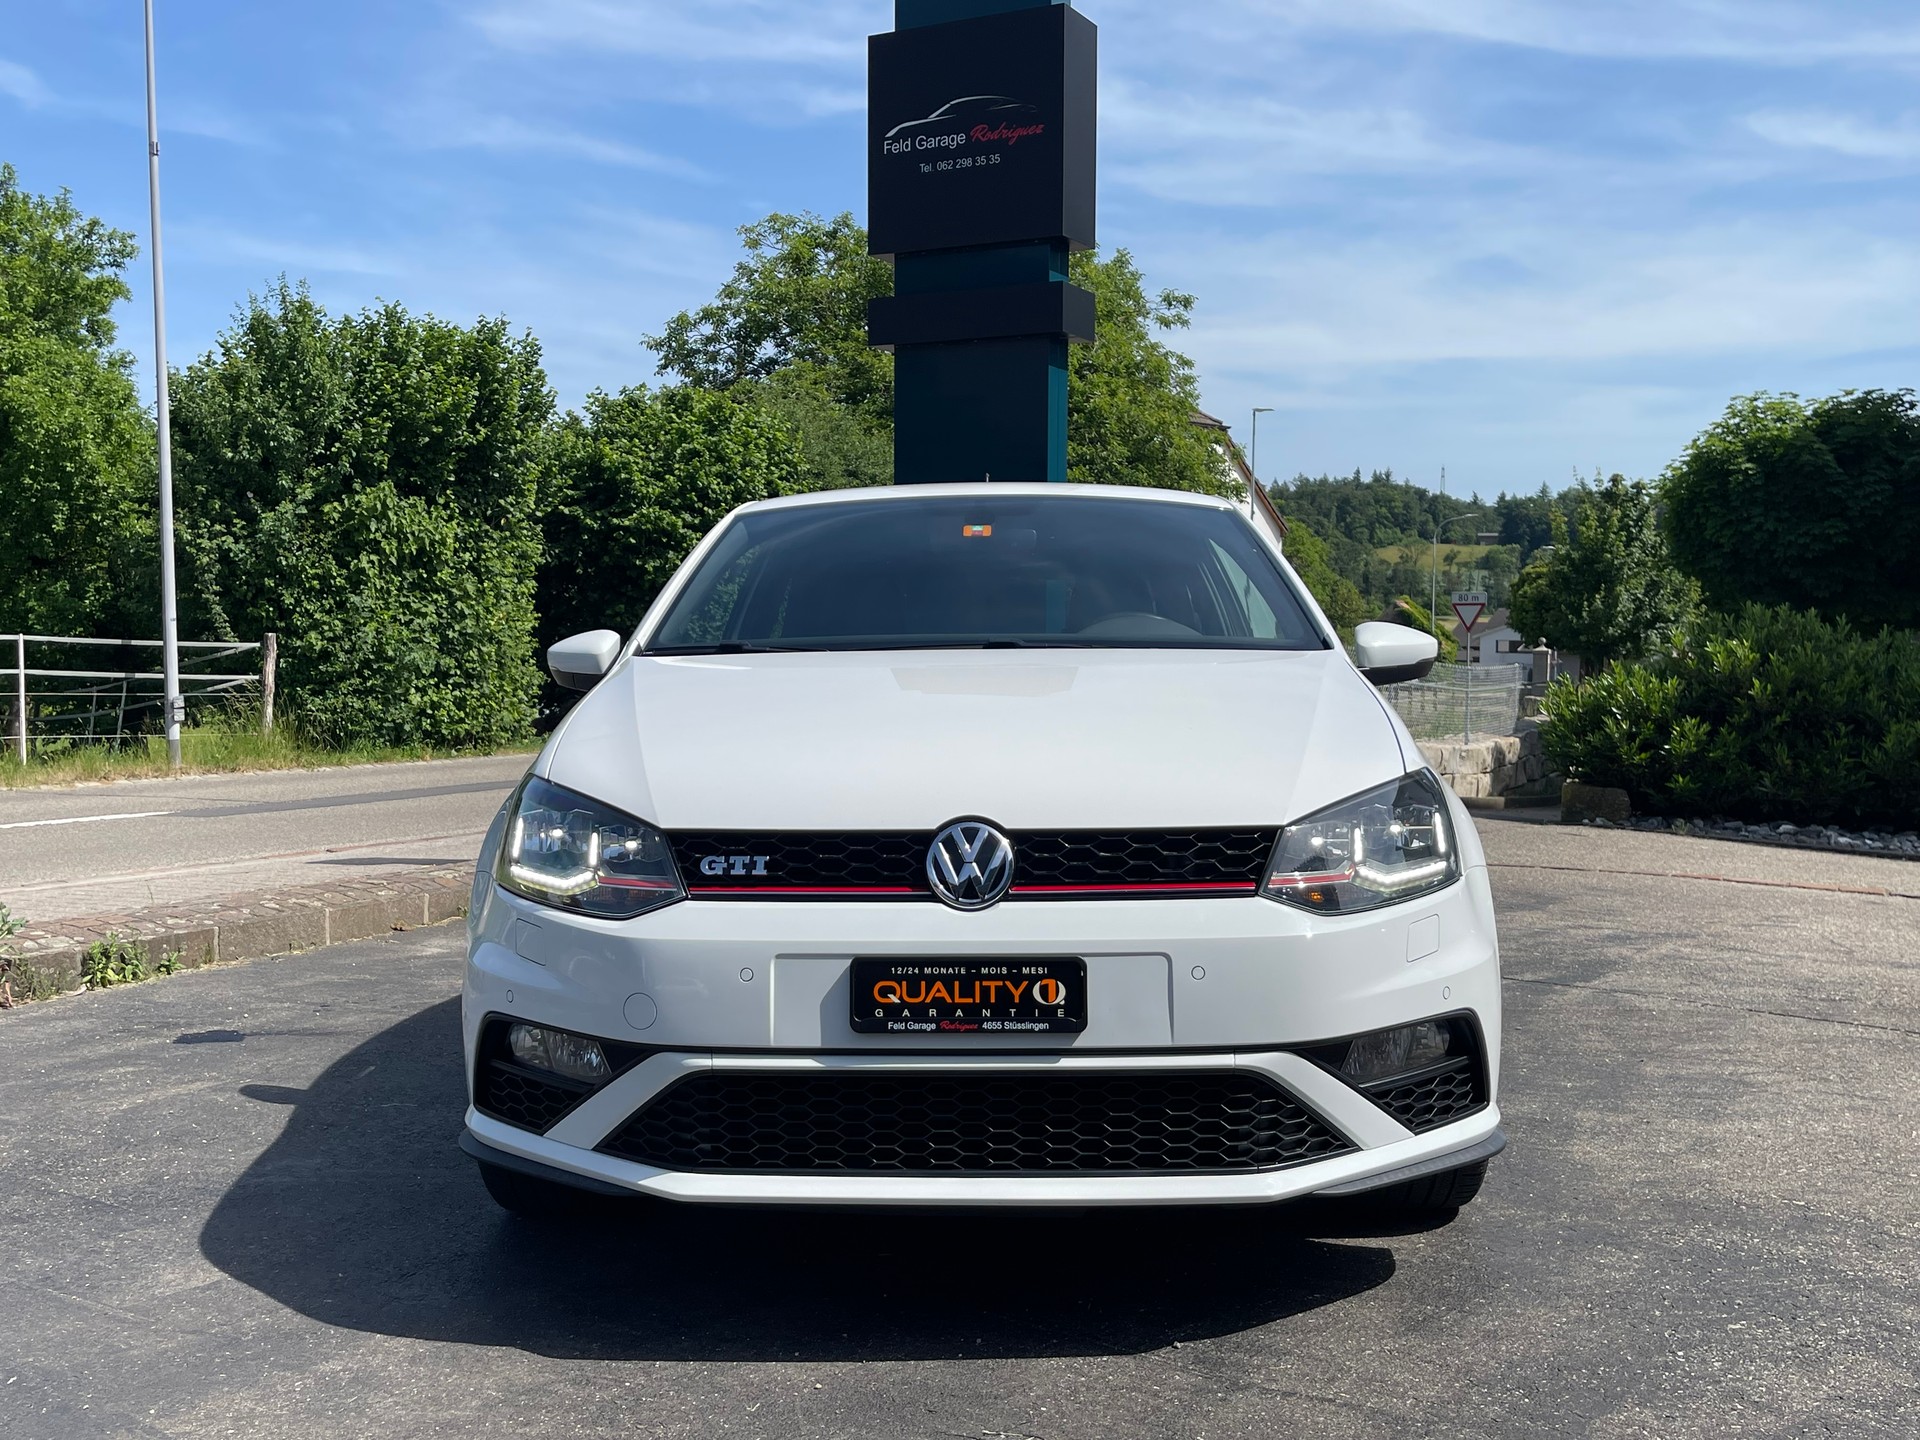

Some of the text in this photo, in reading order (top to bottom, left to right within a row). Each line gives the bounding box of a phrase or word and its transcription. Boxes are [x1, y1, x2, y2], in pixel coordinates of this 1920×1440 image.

[883, 122, 1046, 155] Feld Garage Rodriguez
[919, 153, 1001, 173] Tel. 062 298 35 35
[700, 855, 770, 876] GTI
[891, 967, 919, 975] 12/24
[924, 967, 966, 975] MONATE
[981, 967, 1008, 975] MOIS
[1022, 967, 1048, 975] MESI
[873, 981, 1029, 1003] QUALITY
[874, 1008, 1065, 1017] GARANTIE
[888, 1021, 905, 1030] Feld
[907, 1021, 936, 1031] Garage
[982, 1021, 1002, 1030] 4655
[1003, 1021, 1049, 1031] Stüsslingen
